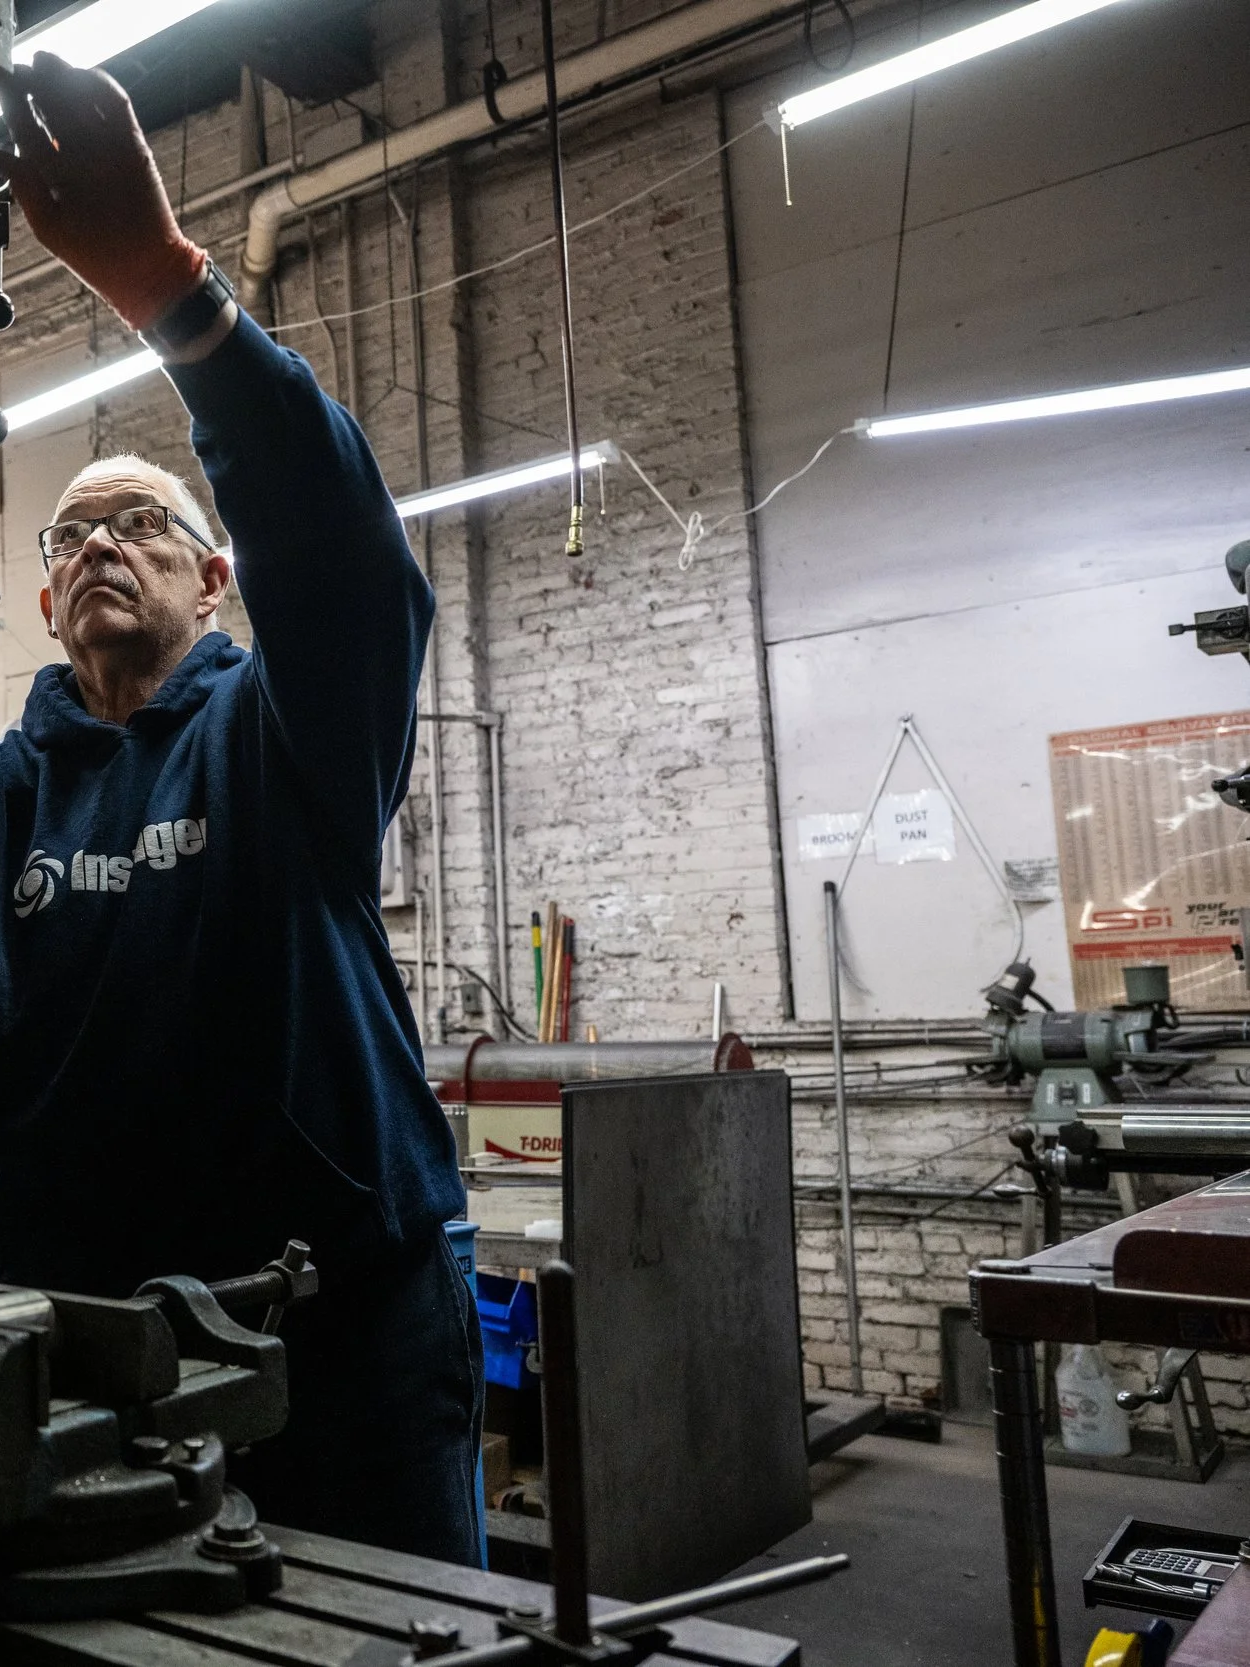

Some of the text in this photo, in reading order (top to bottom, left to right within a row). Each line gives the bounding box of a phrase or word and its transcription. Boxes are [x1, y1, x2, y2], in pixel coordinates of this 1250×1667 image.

[895, 809, 928, 824] DUST
[900, 829, 927, 842] PAN
[71, 817, 207, 893] Insge
[1186, 902, 1226, 915] your
